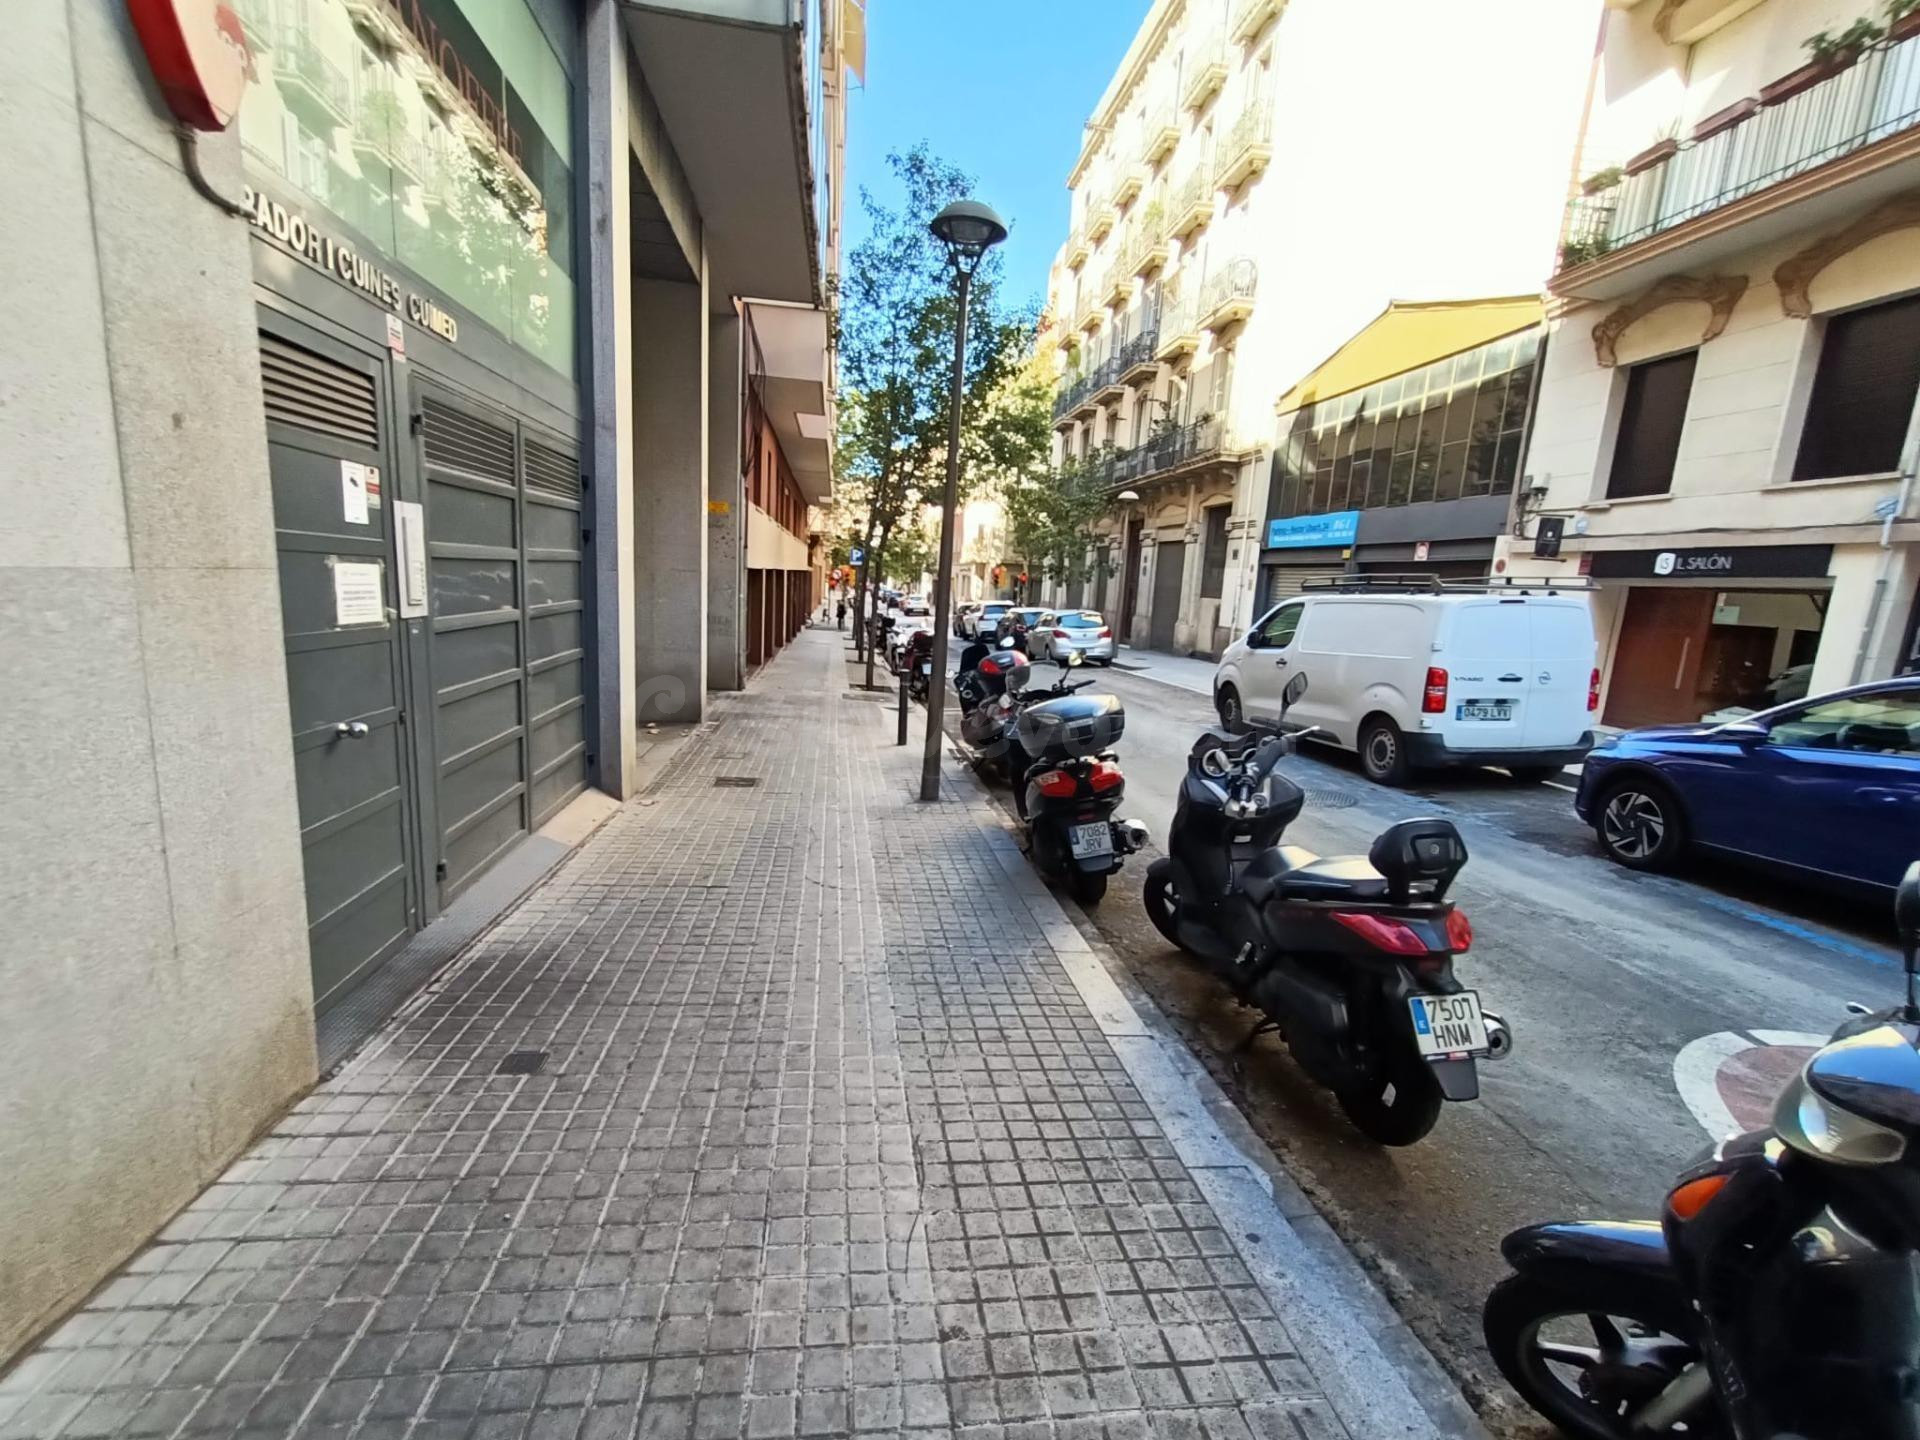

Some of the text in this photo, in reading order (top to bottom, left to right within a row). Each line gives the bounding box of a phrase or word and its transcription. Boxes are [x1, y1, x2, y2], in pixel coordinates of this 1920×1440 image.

[337, 247, 402, 312] CUINES
[852, 549, 862, 561] P
[1079, 824, 1107, 839] 7082
[1426, 997, 1475, 1023] 7501
[1432, 1022, 1473, 1049] HNM
